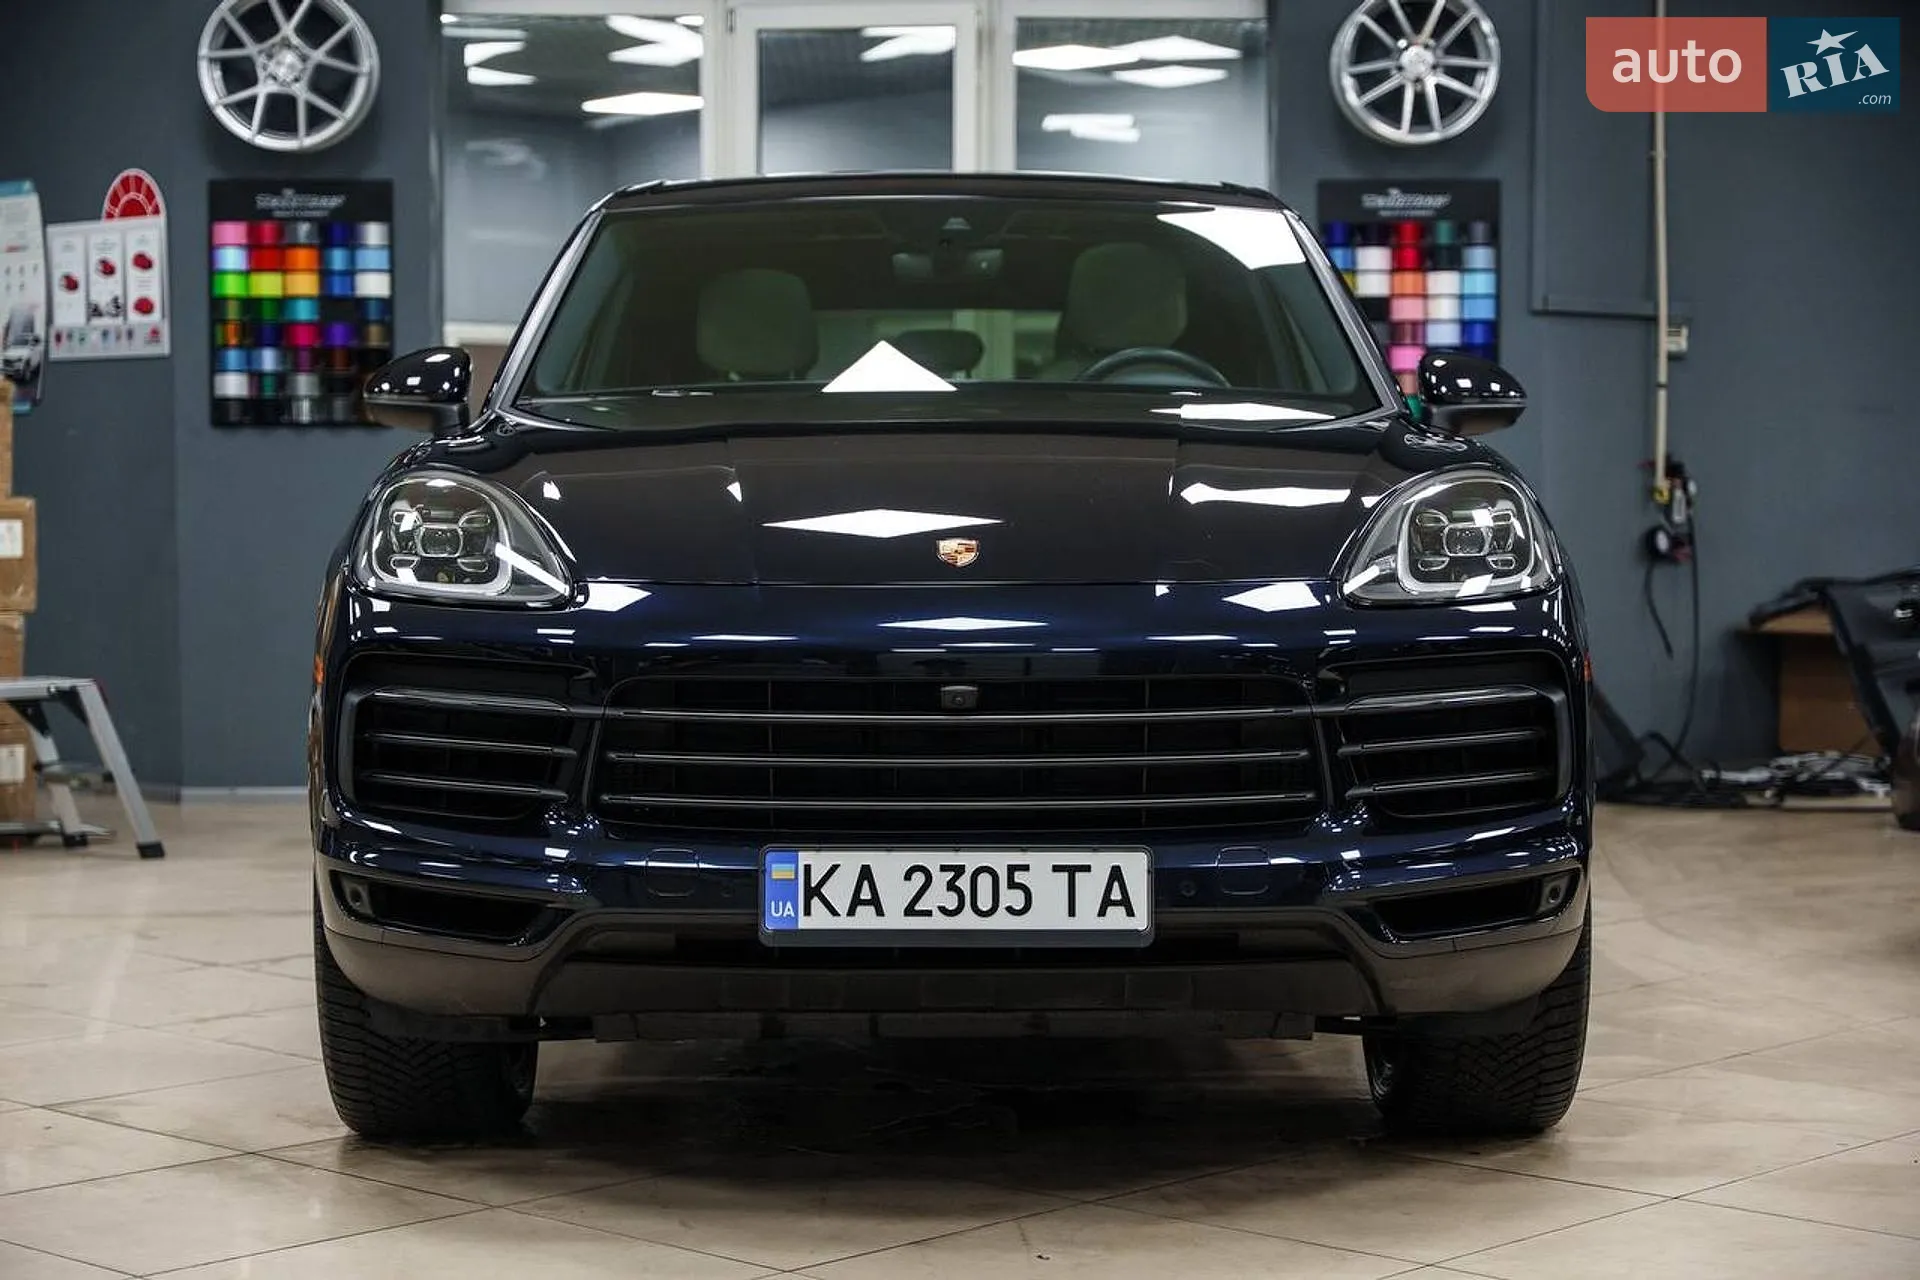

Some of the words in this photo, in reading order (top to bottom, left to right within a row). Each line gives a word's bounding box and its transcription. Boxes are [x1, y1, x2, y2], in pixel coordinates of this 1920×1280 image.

[803, 863, 885, 918] KA
[903, 863, 1033, 918] 2305
[1052, 863, 1136, 918] TA
[771, 900, 795, 918] UA
